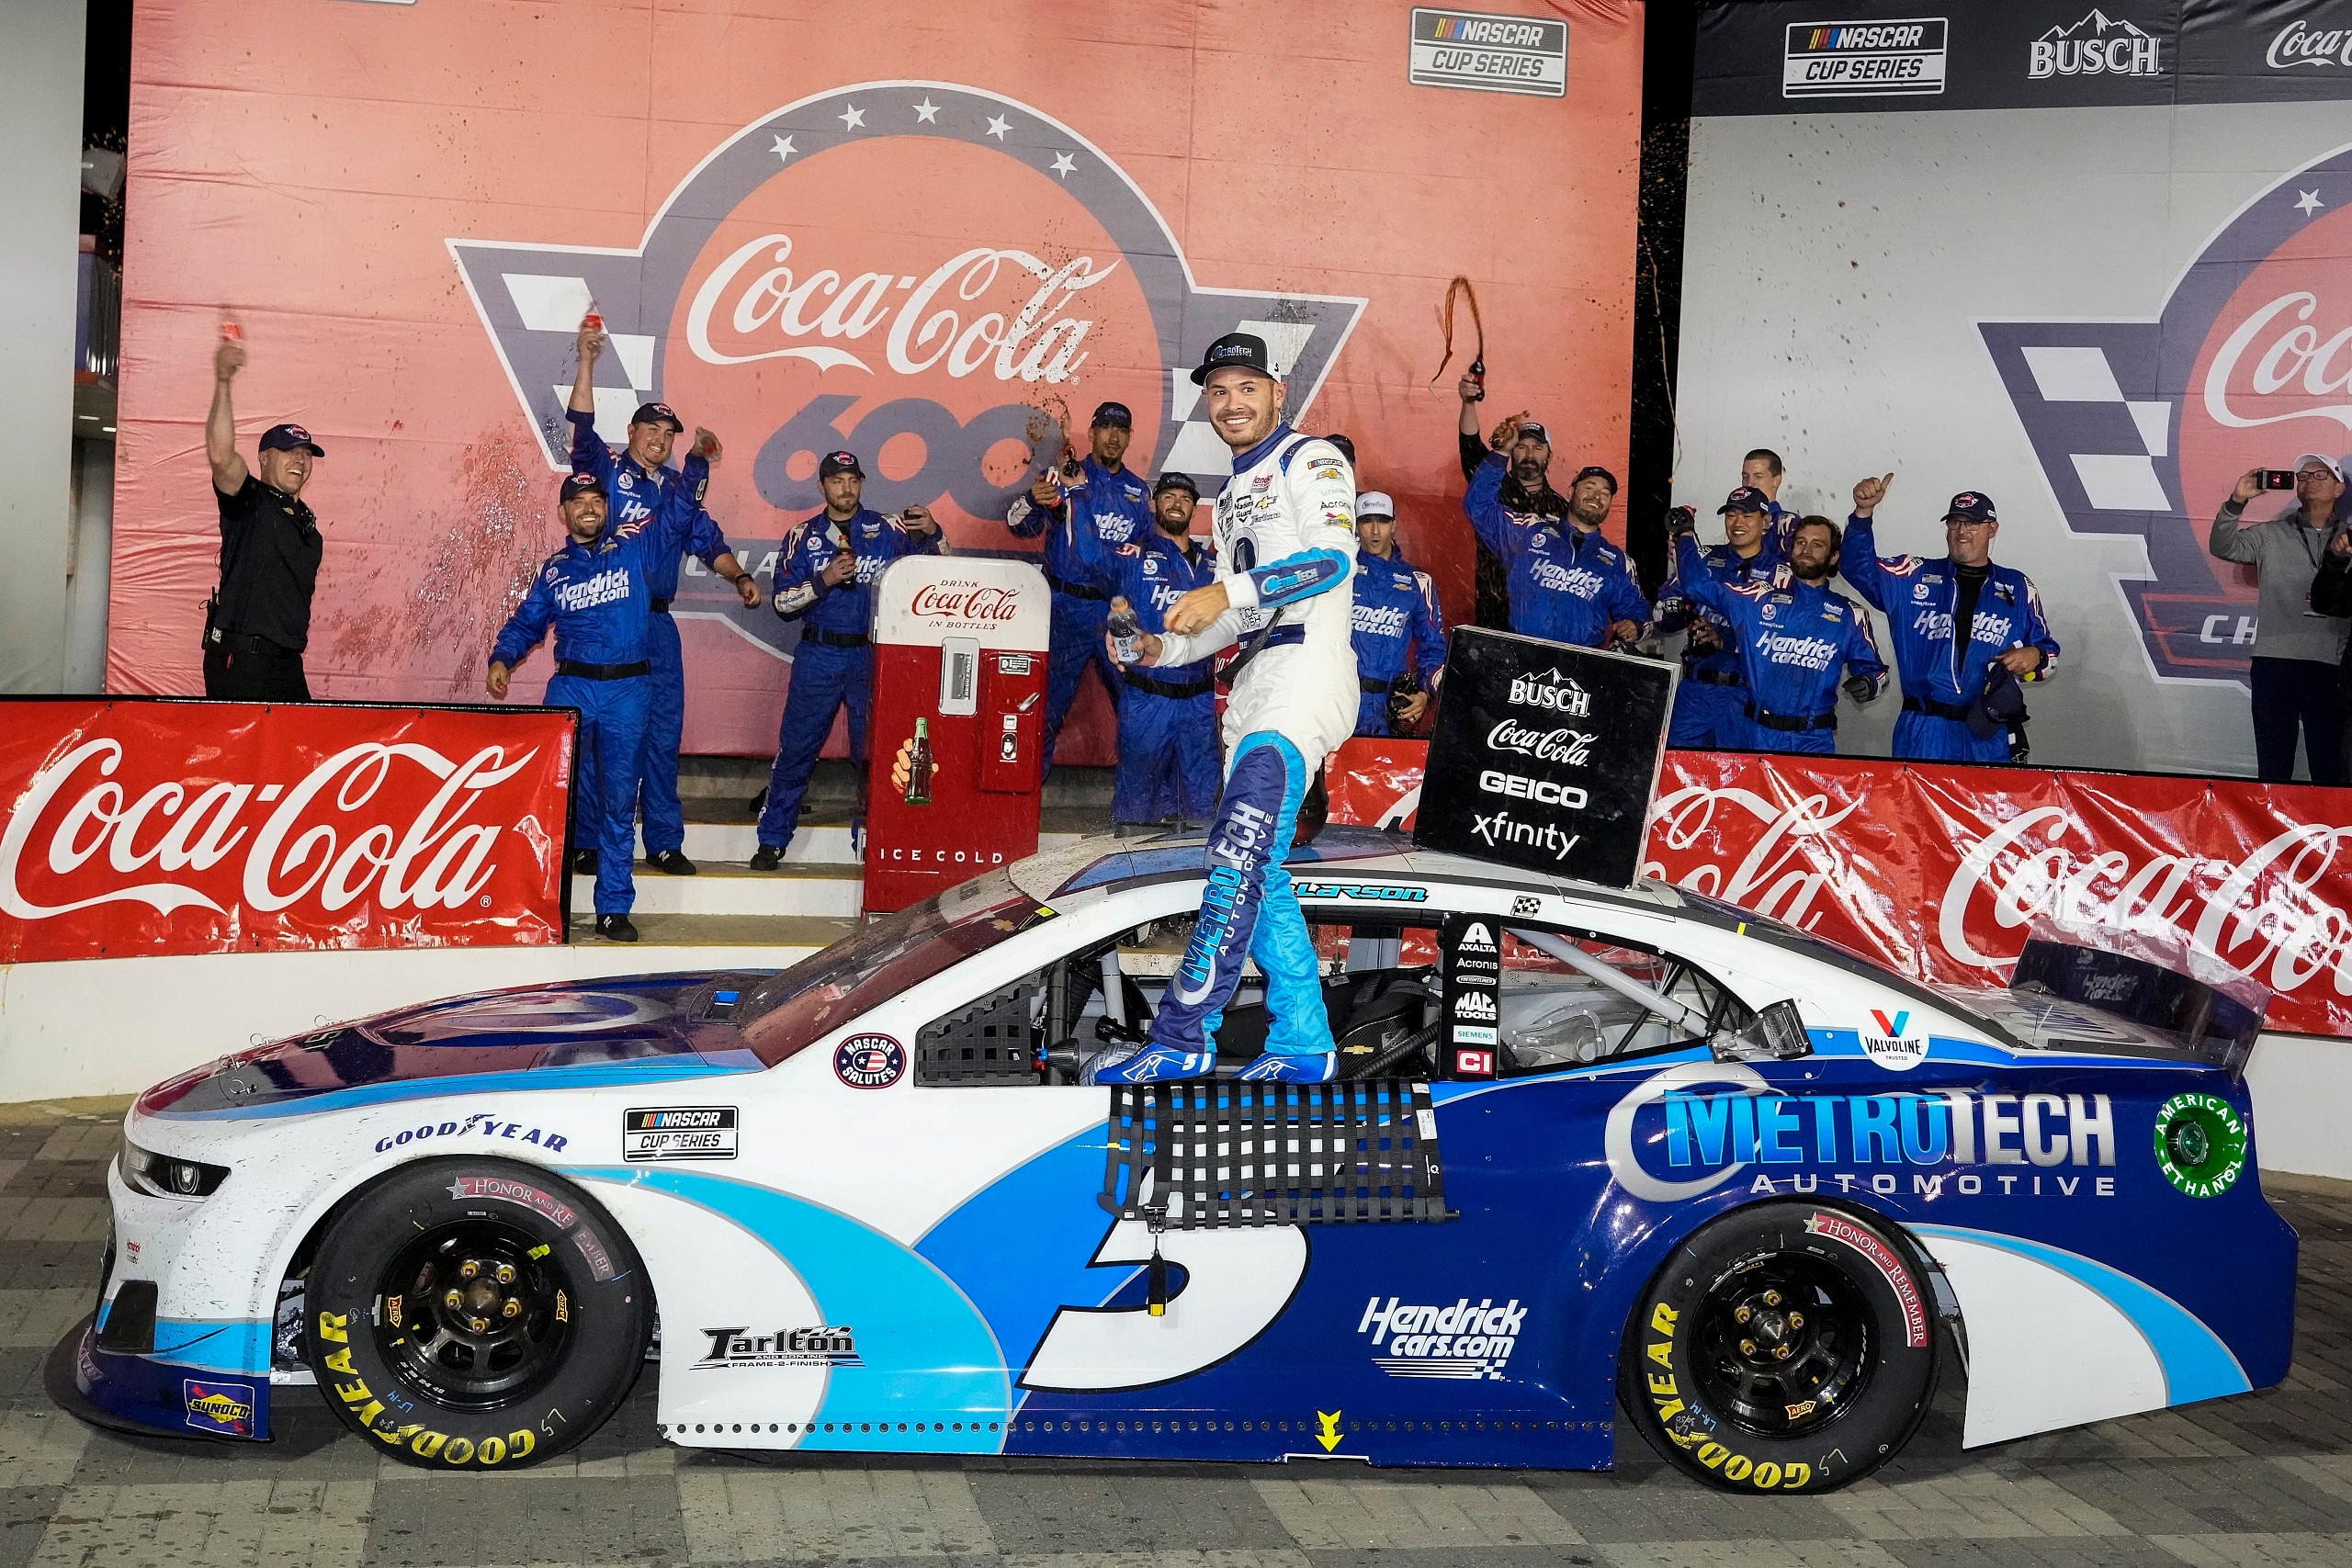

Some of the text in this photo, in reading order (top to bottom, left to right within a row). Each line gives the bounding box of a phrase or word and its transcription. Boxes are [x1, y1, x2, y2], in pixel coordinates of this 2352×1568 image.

[1459, 20, 1545, 48] NASCAR
[1836, 25, 1924, 49] NASCAR
[1432, 50, 1544, 78] CUP SERIES
[1805, 58, 1924, 81] CUP SERIES
[2027, 36, 2161, 79] BUSCH
[686, 233, 1121, 384] Coca-Cola
[751, 393, 1073, 524] 600
[940, 580, 979, 588] DRINK
[1529, 558, 1604, 594] Hendrick
[554, 567, 629, 611] Hendrick
[570, 586, 629, 612] cars.com
[1540, 576, 1595, 603] cars.com
[911, 584, 1021, 621] Coca-Cola
[946, 622, 998, 631] BOTTLES
[1351, 604, 1410, 628] endrick
[1755, 630, 1838, 662] Hendrick
[1771, 652, 1830, 671] cars.com
[1508, 679, 1591, 717] BUSCH
[1487, 718, 1599, 767] Coca-Cola
[1479, 769, 1589, 809] GEICO
[0, 737, 540, 918] Coca-Cola
[1471, 811, 1580, 861] xfinity
[880, 848, 1004, 864] ICE COLD
[1457, 942, 1498, 953] AXALTA
[1456, 957, 1498, 970] Acronis
[1455, 991, 1497, 1012] MAC
[1455, 1011, 1497, 1021] TOOLS
[843, 1038, 896, 1056] NASCAR
[1457, 1031, 1493, 1040] SIEMENS
[1864, 1036, 1922, 1056] VALVOLINE
[1459, 1053, 1491, 1073] CI
[842, 1066, 897, 1086] SALUTES
[660, 1111, 721, 1128] NASCAR
[2154, 1093, 2242, 1136] AMERICAN
[639, 1133, 721, 1150] CUP SERIES
[1749, 1173, 2116, 1196] AUTOMOTIVE
[2162, 1158, 2243, 1197] ETHANOL
[473, 1178, 533, 1203] HONOR
[534, 1196, 554, 1211] AND
[1826, 1218, 1927, 1345] HONOR AND REMEMBER
[390, 1299, 400, 1325] AERO
[558, 1301, 567, 1319] AERO
[1357, 1296, 1528, 1346] Hendrick
[699, 1325, 856, 1362] Tarlton
[1389, 1334, 1515, 1359] cars.com
[191, 1400, 251, 1419] SUNOCO
[1791, 1403, 1812, 1416] AERO
